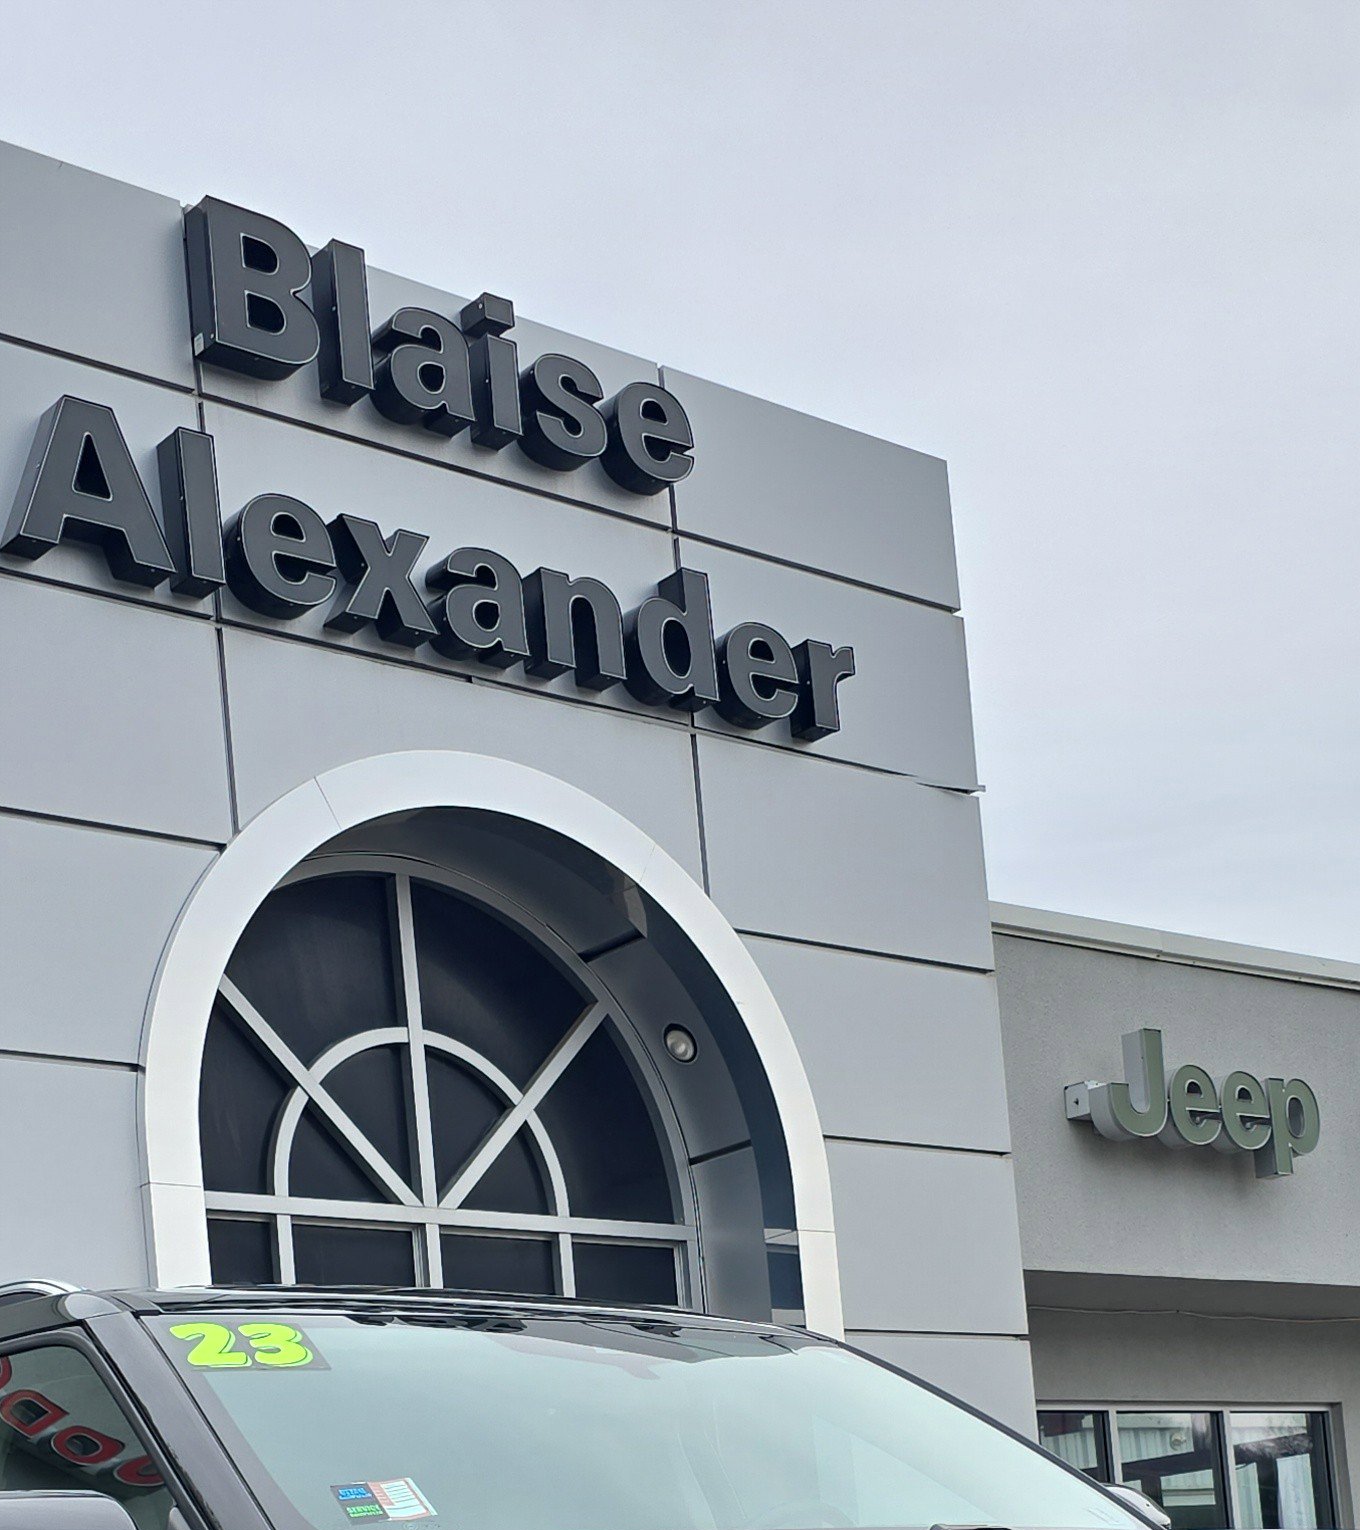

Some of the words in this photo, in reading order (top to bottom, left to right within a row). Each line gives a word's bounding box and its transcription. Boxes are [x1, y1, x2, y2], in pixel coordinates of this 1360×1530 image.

[183, 195, 695, 495] Blaise
[0, 394, 855, 743] Alexander
[1091, 1028, 1321, 1177] Jeep
[169, 1322, 314, 1368] 23
